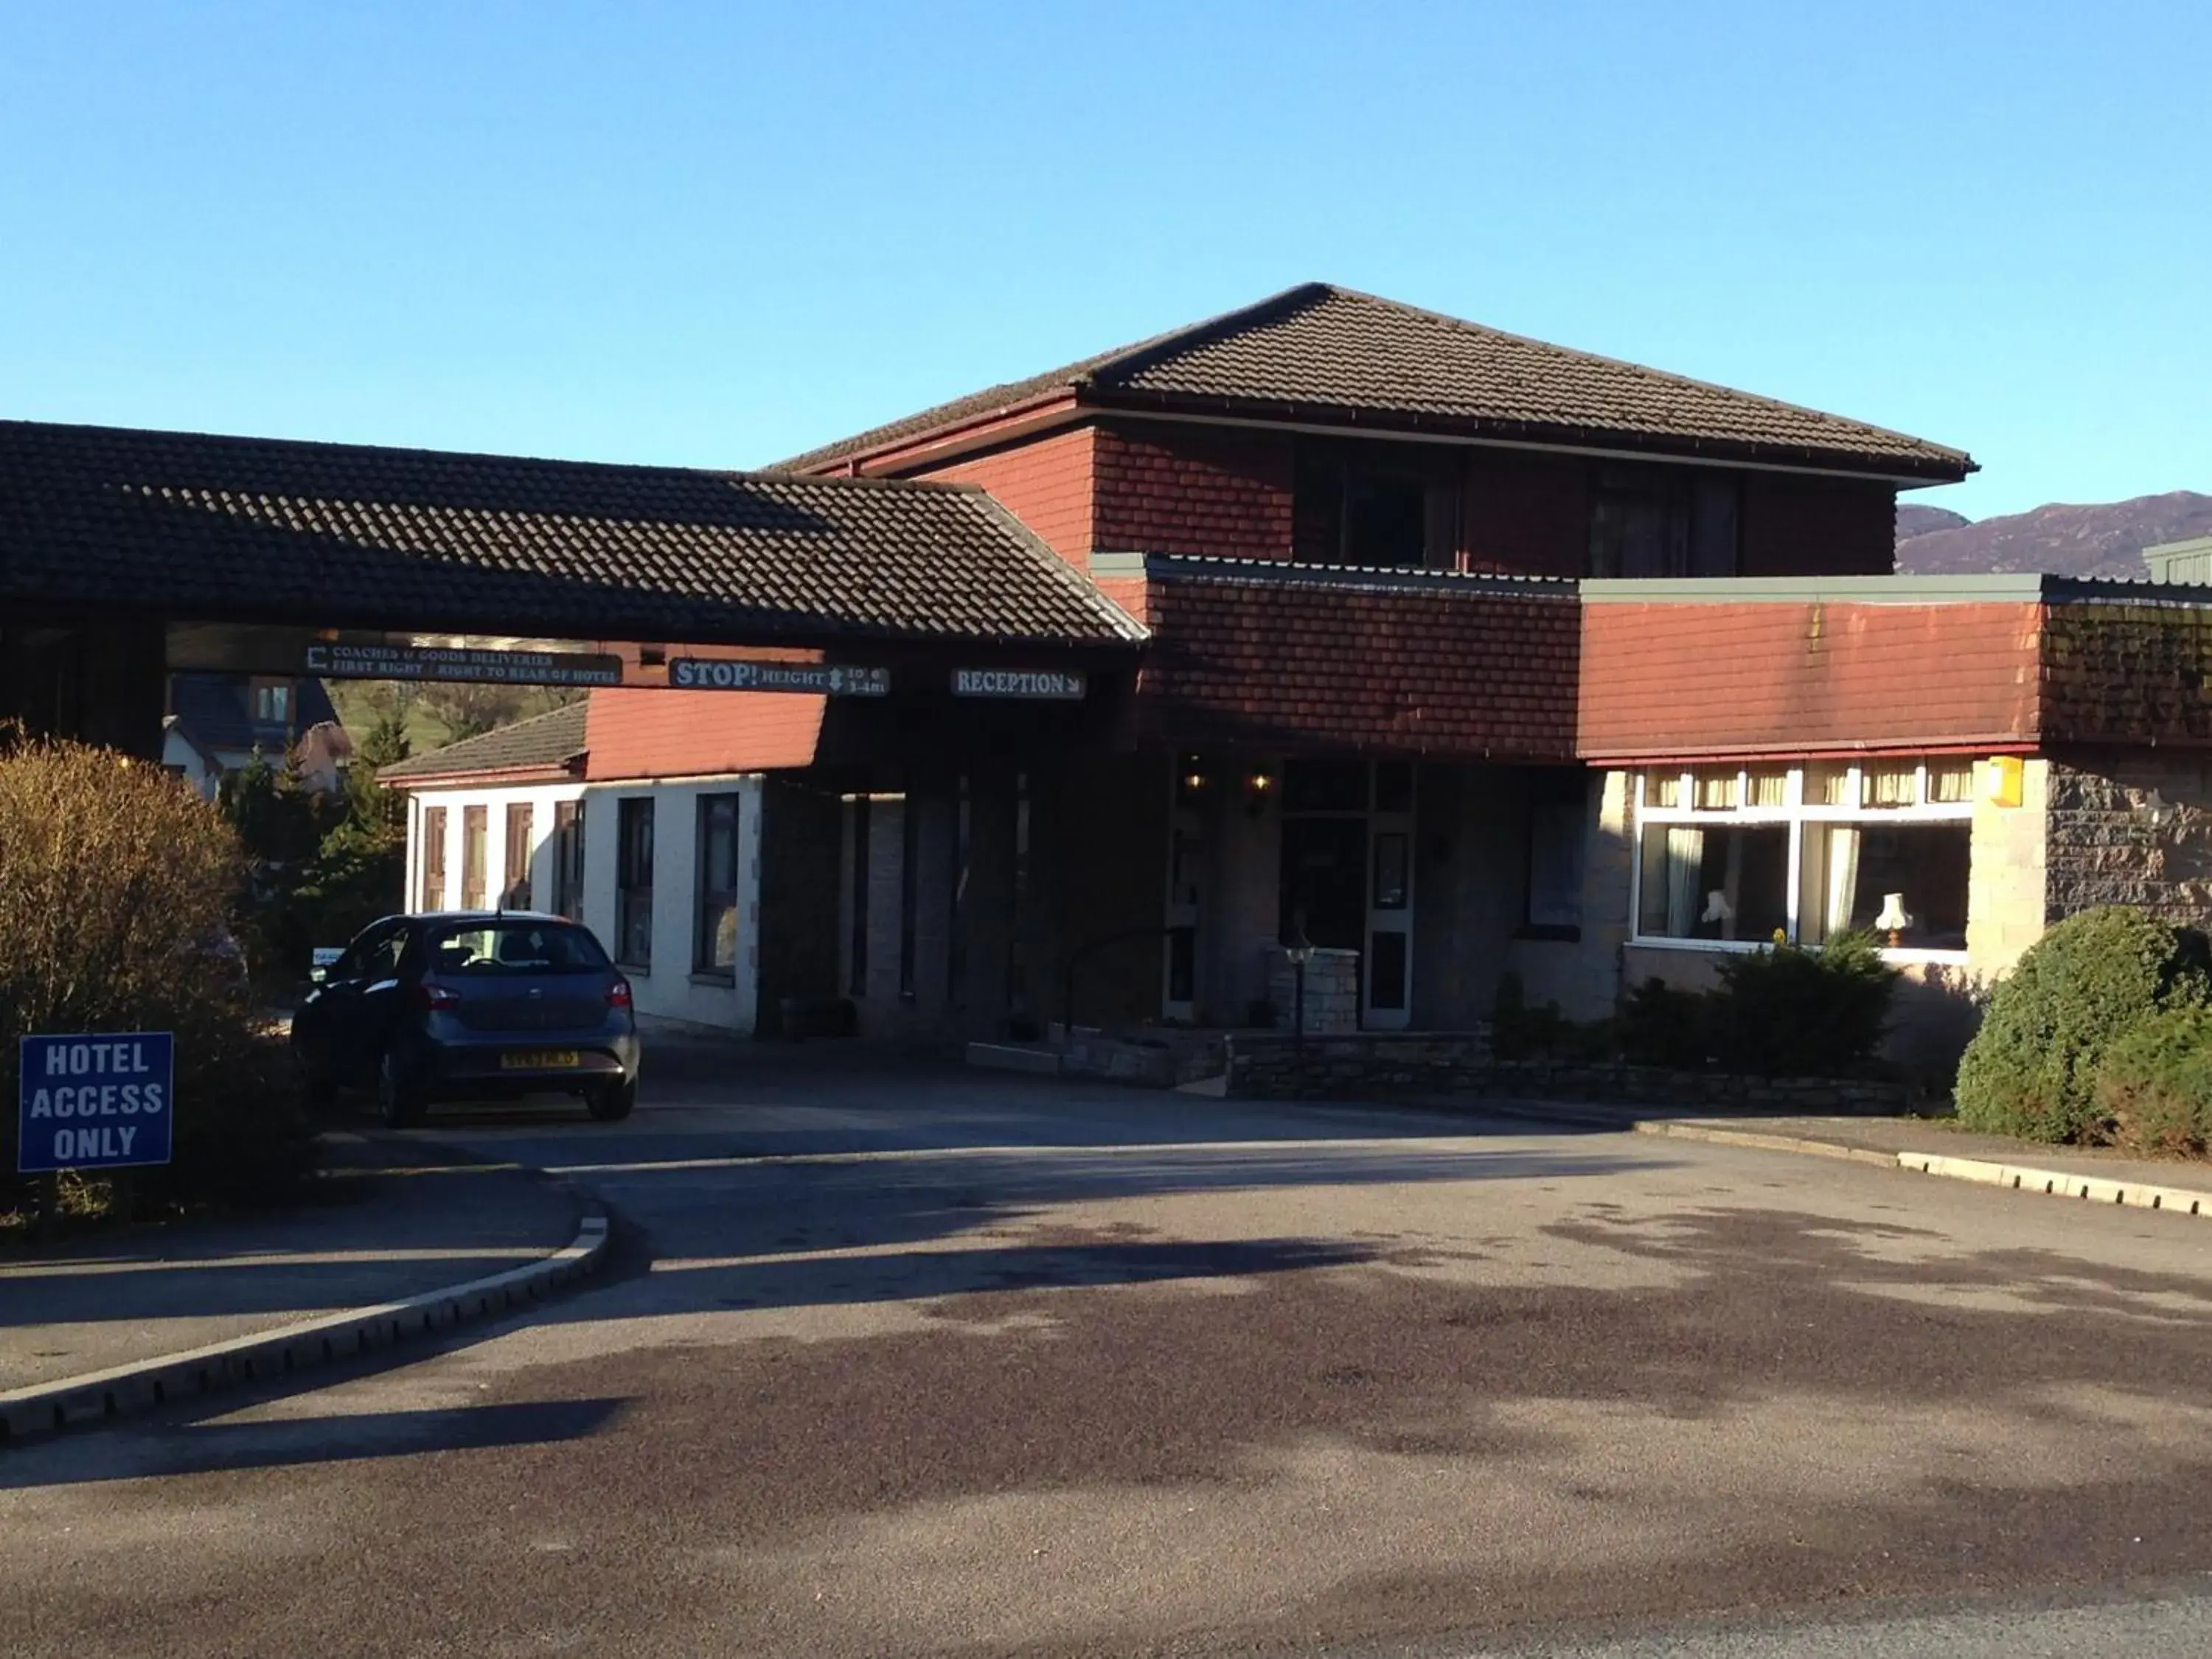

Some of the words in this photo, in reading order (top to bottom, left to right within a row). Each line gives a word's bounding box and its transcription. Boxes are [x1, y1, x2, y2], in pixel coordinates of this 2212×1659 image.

[418, 650, 467, 662] GOODS
[471, 652, 553, 666] DELIVERIES
[333, 660, 375, 672] FIRST
[378, 661, 422, 674] RIGHT
[437, 664, 481, 677] RIGHT
[487, 667, 505, 678] TO
[509, 667, 549, 680] REAR
[551, 669, 570, 681] OF
[573, 669, 616, 683] HOTEL
[676, 662, 758, 686] STOP!
[762, 669, 827, 686] HEIGHT
[958, 671, 1064, 694] RECEPTION
[45, 1042, 150, 1076] HOTEL
[30, 1082, 163, 1119] ACCESS
[54, 1126, 137, 1160] ONLY
